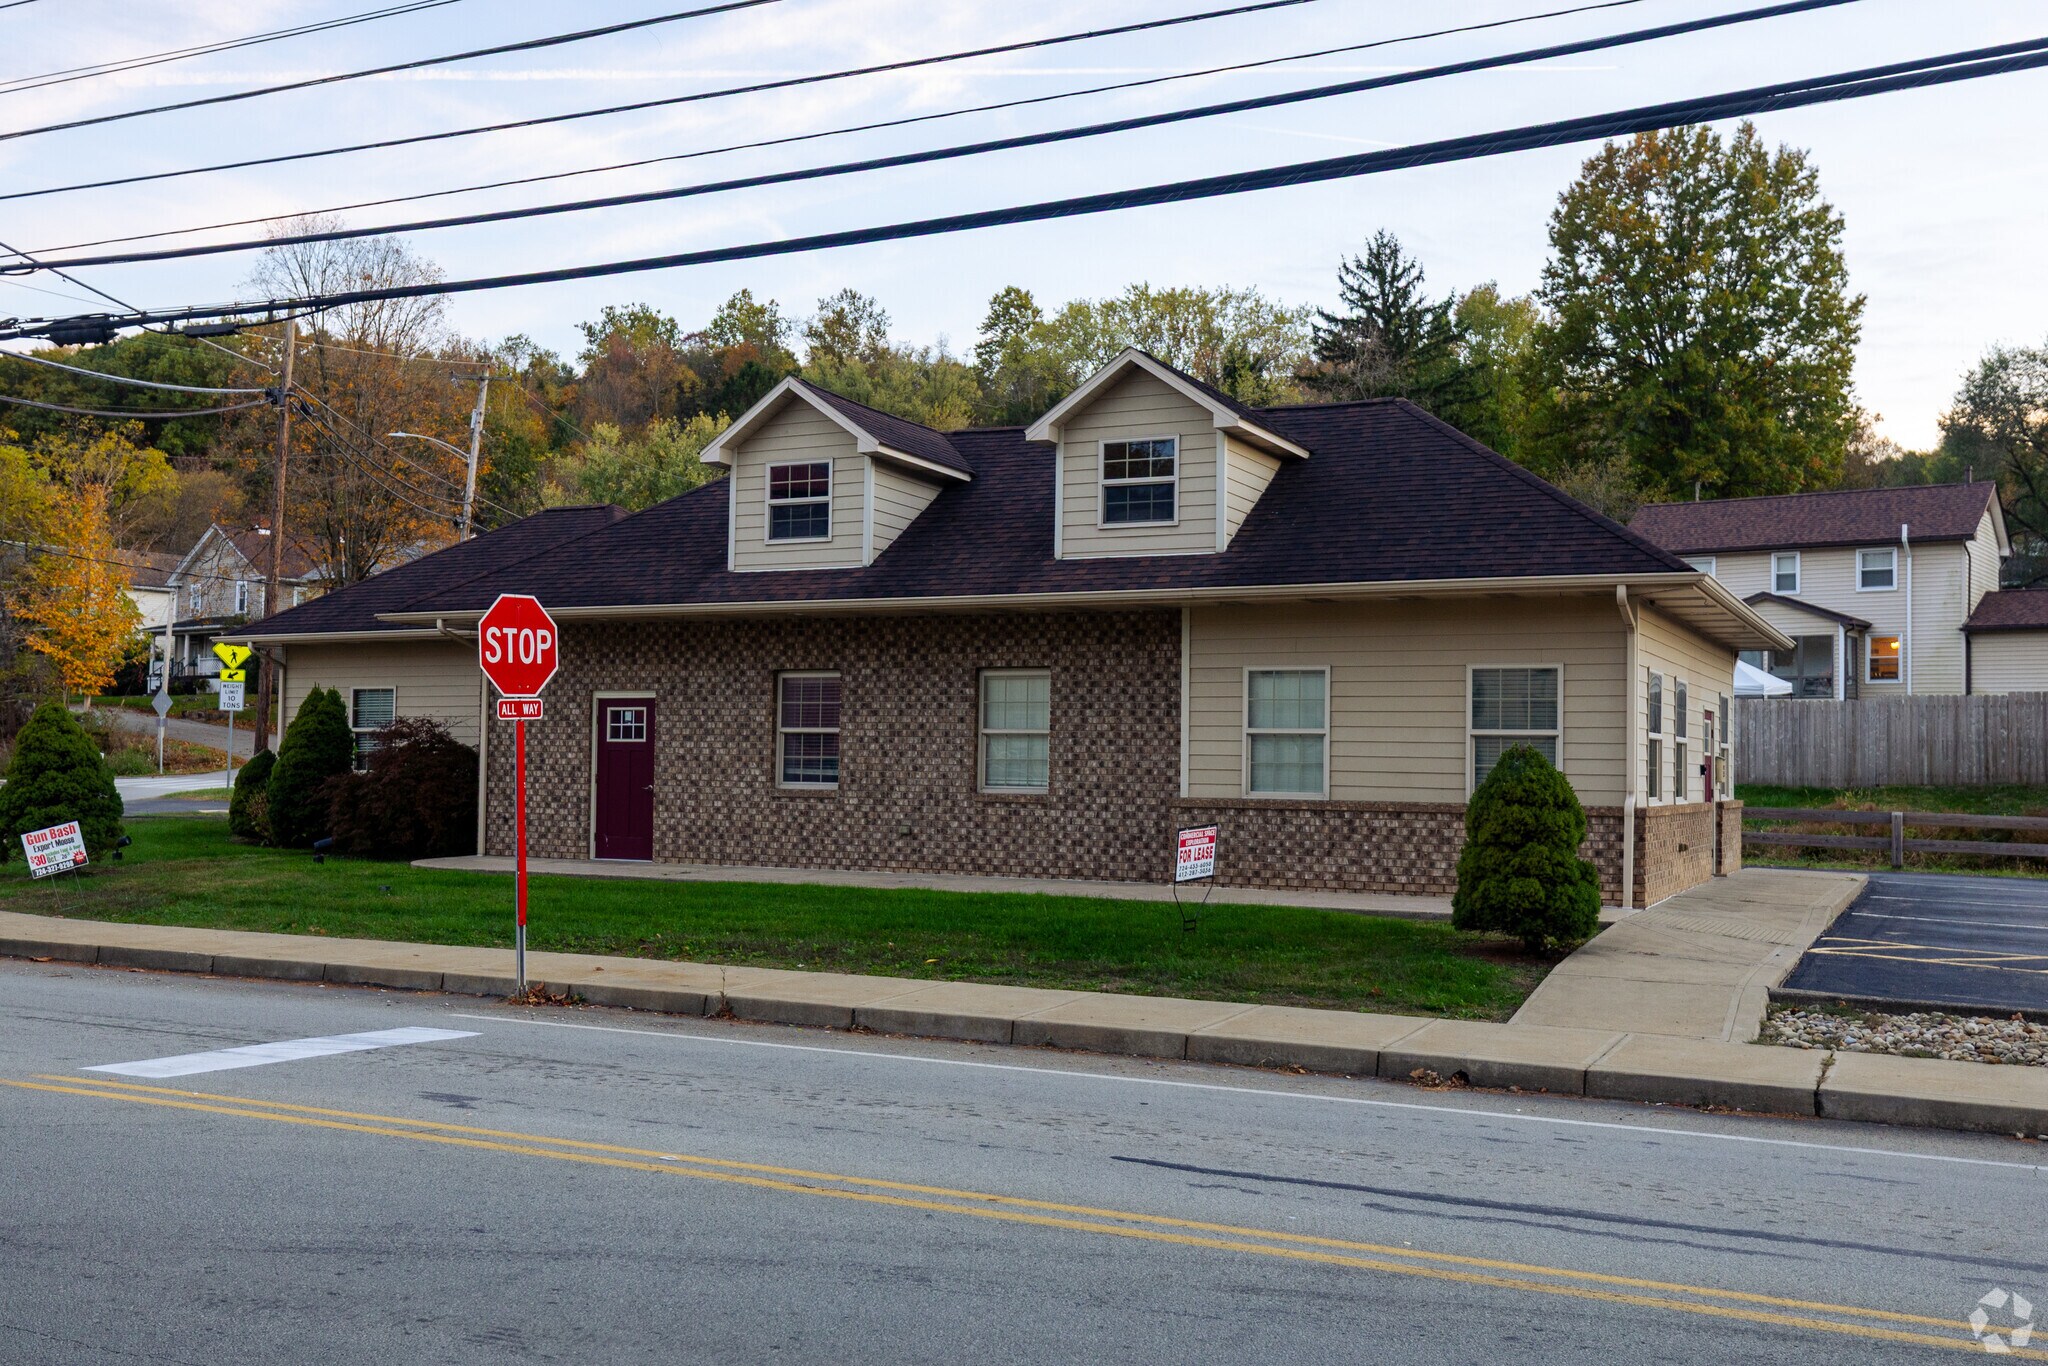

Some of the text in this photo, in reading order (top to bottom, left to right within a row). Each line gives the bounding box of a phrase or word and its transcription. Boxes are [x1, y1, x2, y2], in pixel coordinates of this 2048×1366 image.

[485, 626, 552, 664] STOP
[502, 704, 539, 715] ALL WAY
[26, 824, 76, 845] Gun Bash
[30, 854, 47, 866] $30
[1179, 846, 1213, 863] FOR LEASE
